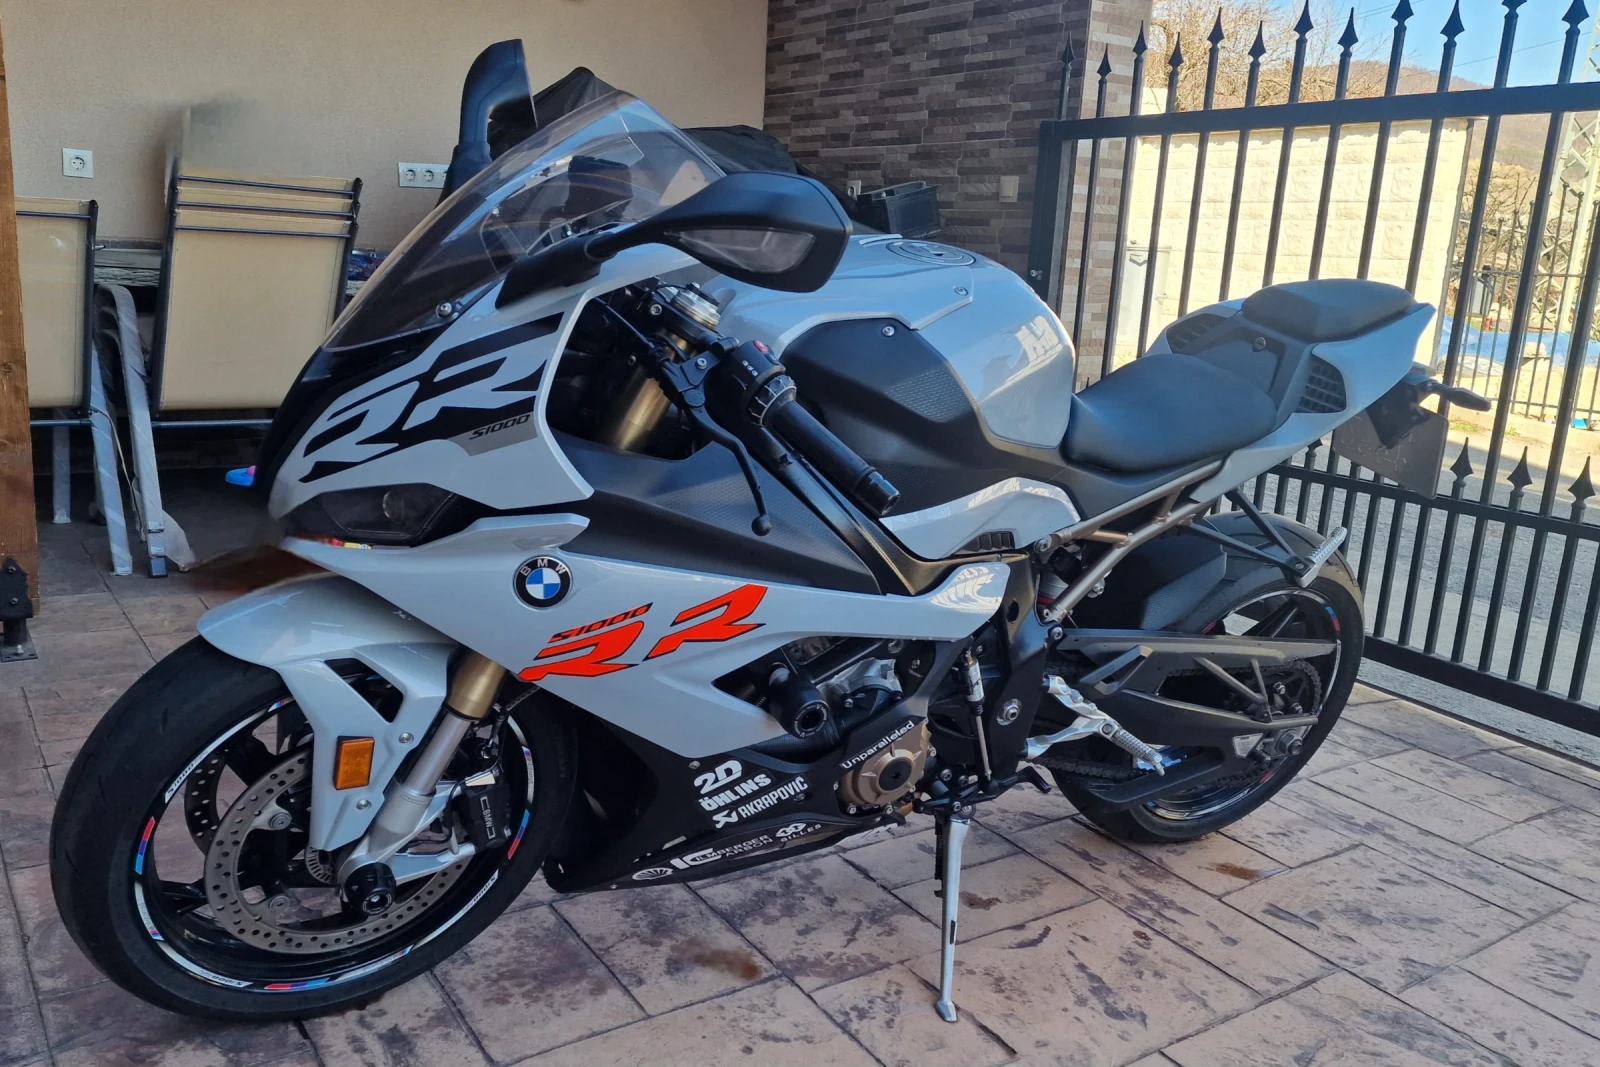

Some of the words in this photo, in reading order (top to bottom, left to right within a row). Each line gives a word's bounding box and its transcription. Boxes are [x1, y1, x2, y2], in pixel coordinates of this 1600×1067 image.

[469, 415, 530, 440] S1000
[520, 558, 567, 576] BMW
[518, 583, 768, 682] RR
[548, 602, 653, 643] S1000
[841, 720, 915, 769] Unparalleled
[693, 759, 743, 795] 2D
[698, 773, 772, 811] ÖHLINS
[482, 809, 493, 829] BMW
